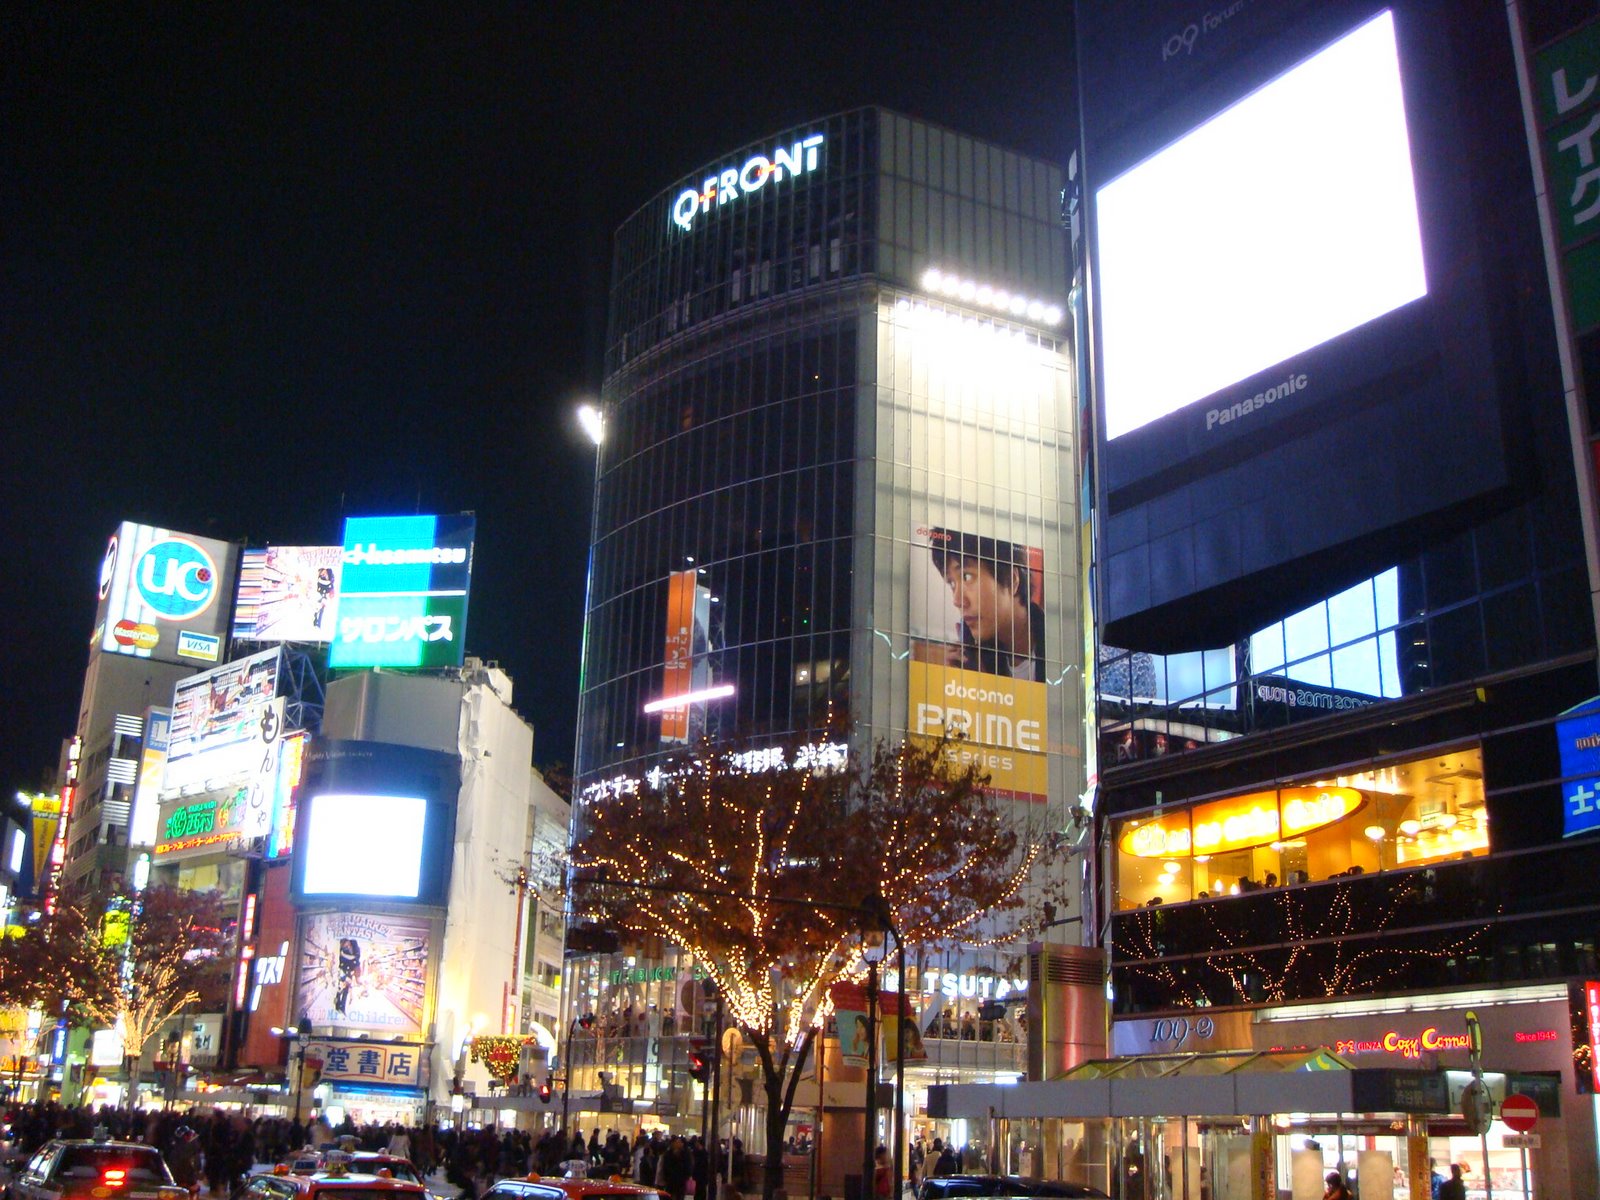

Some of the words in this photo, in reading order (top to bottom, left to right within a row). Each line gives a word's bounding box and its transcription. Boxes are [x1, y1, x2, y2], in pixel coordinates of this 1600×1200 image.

[1162, 24, 1199, 61] 109
[673, 134, 824, 231] QFRONT
[1205, 374, 1308, 431] Panasonic
[916, 527, 952, 541] docomo
[141, 553, 209, 602] UC
[341, 614, 454, 643] サロンパス
[186, 640, 211, 653] VISA
[944, 679, 1014, 707] docomo
[917, 702, 1040, 752] PRIME
[250, 704, 280, 828] もんじゃ
[945, 748, 1014, 771] series
[923, 971, 1029, 1000] TSUTAY
[1358, 1041, 1382, 1052] GINZA
[1382, 1031, 1420, 1058] Cozy
